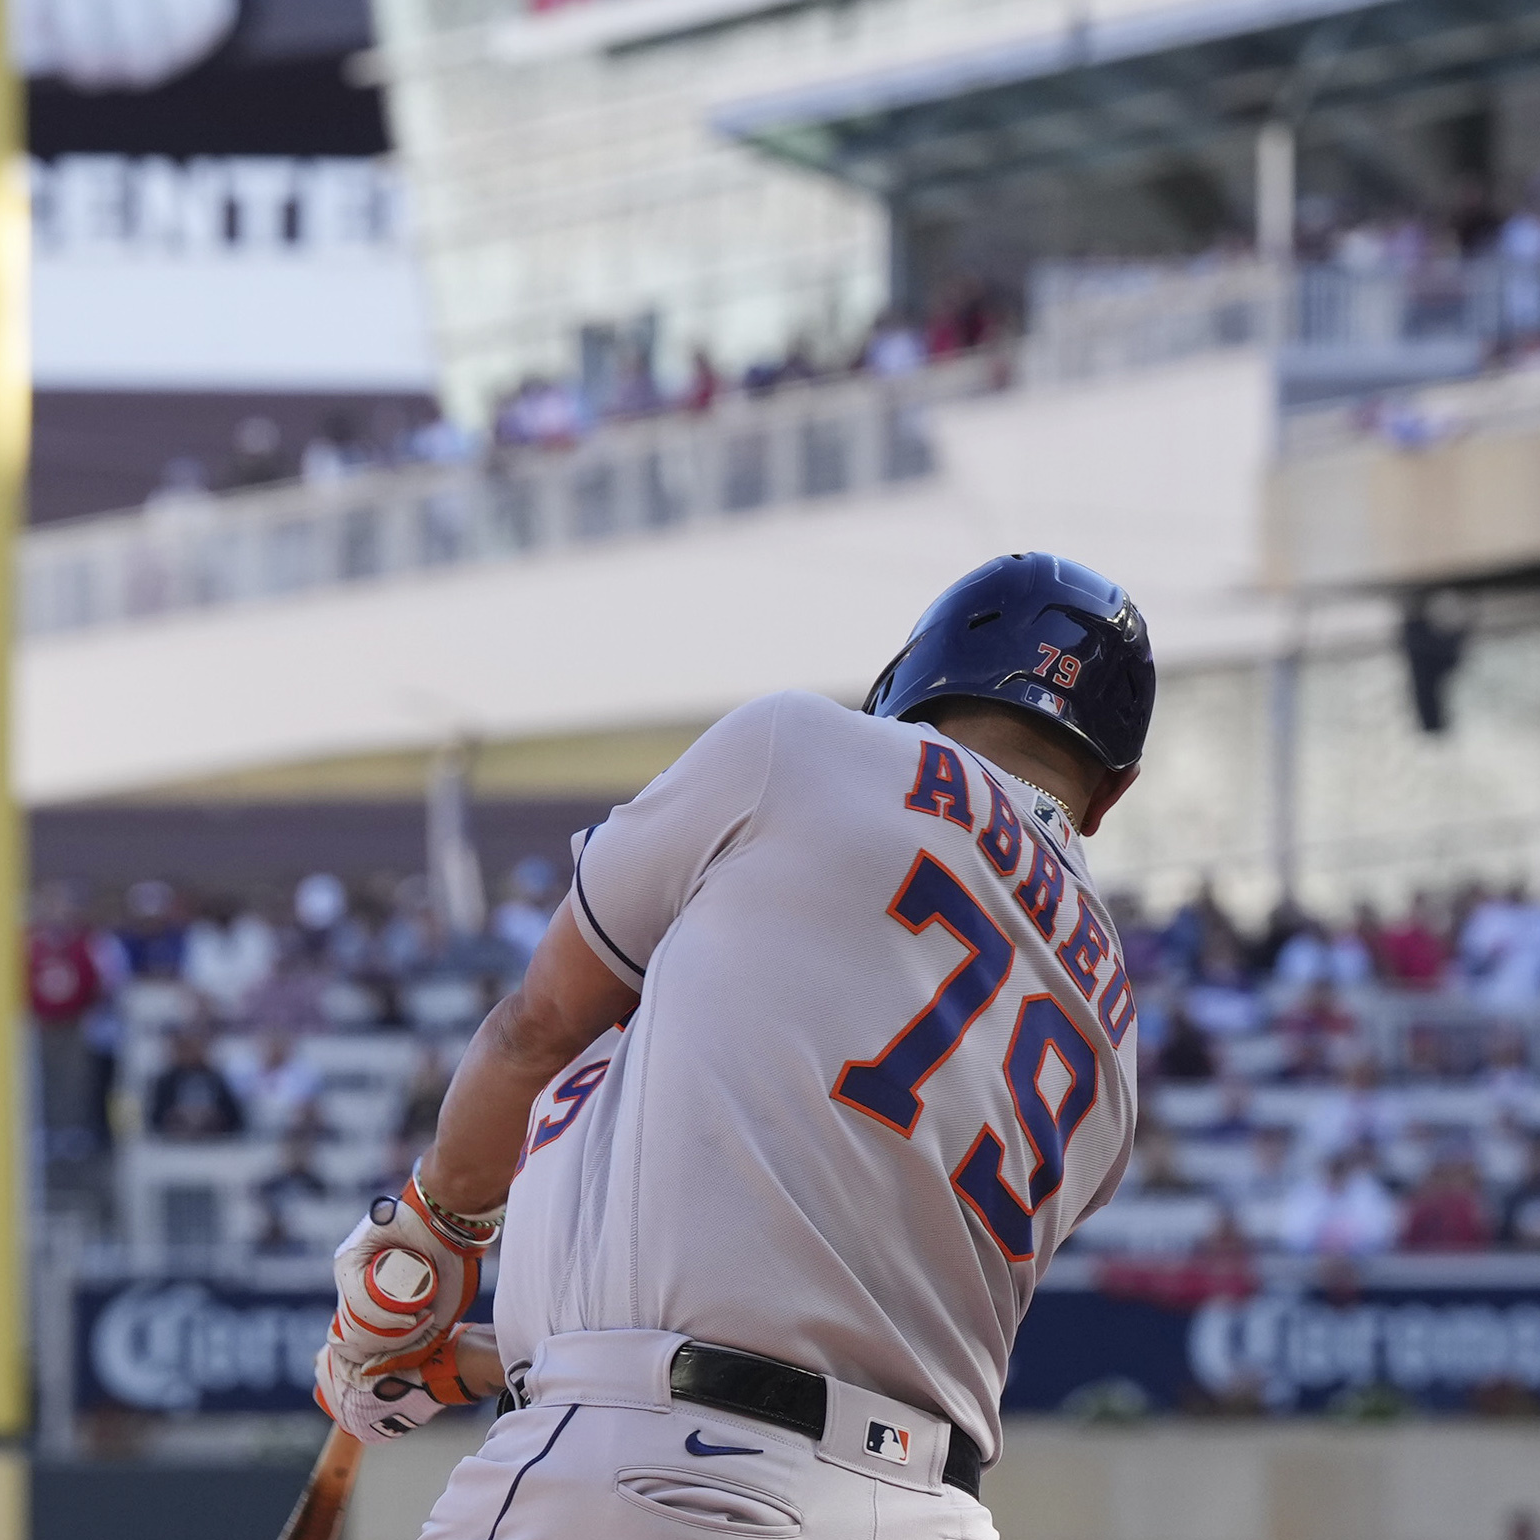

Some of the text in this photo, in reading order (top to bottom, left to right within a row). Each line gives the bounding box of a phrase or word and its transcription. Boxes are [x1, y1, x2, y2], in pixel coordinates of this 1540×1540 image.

[1032, 642, 1082, 690] 79
[905, 739, 1137, 1051] ABREU
[829, 847, 1099, 1262] 79
